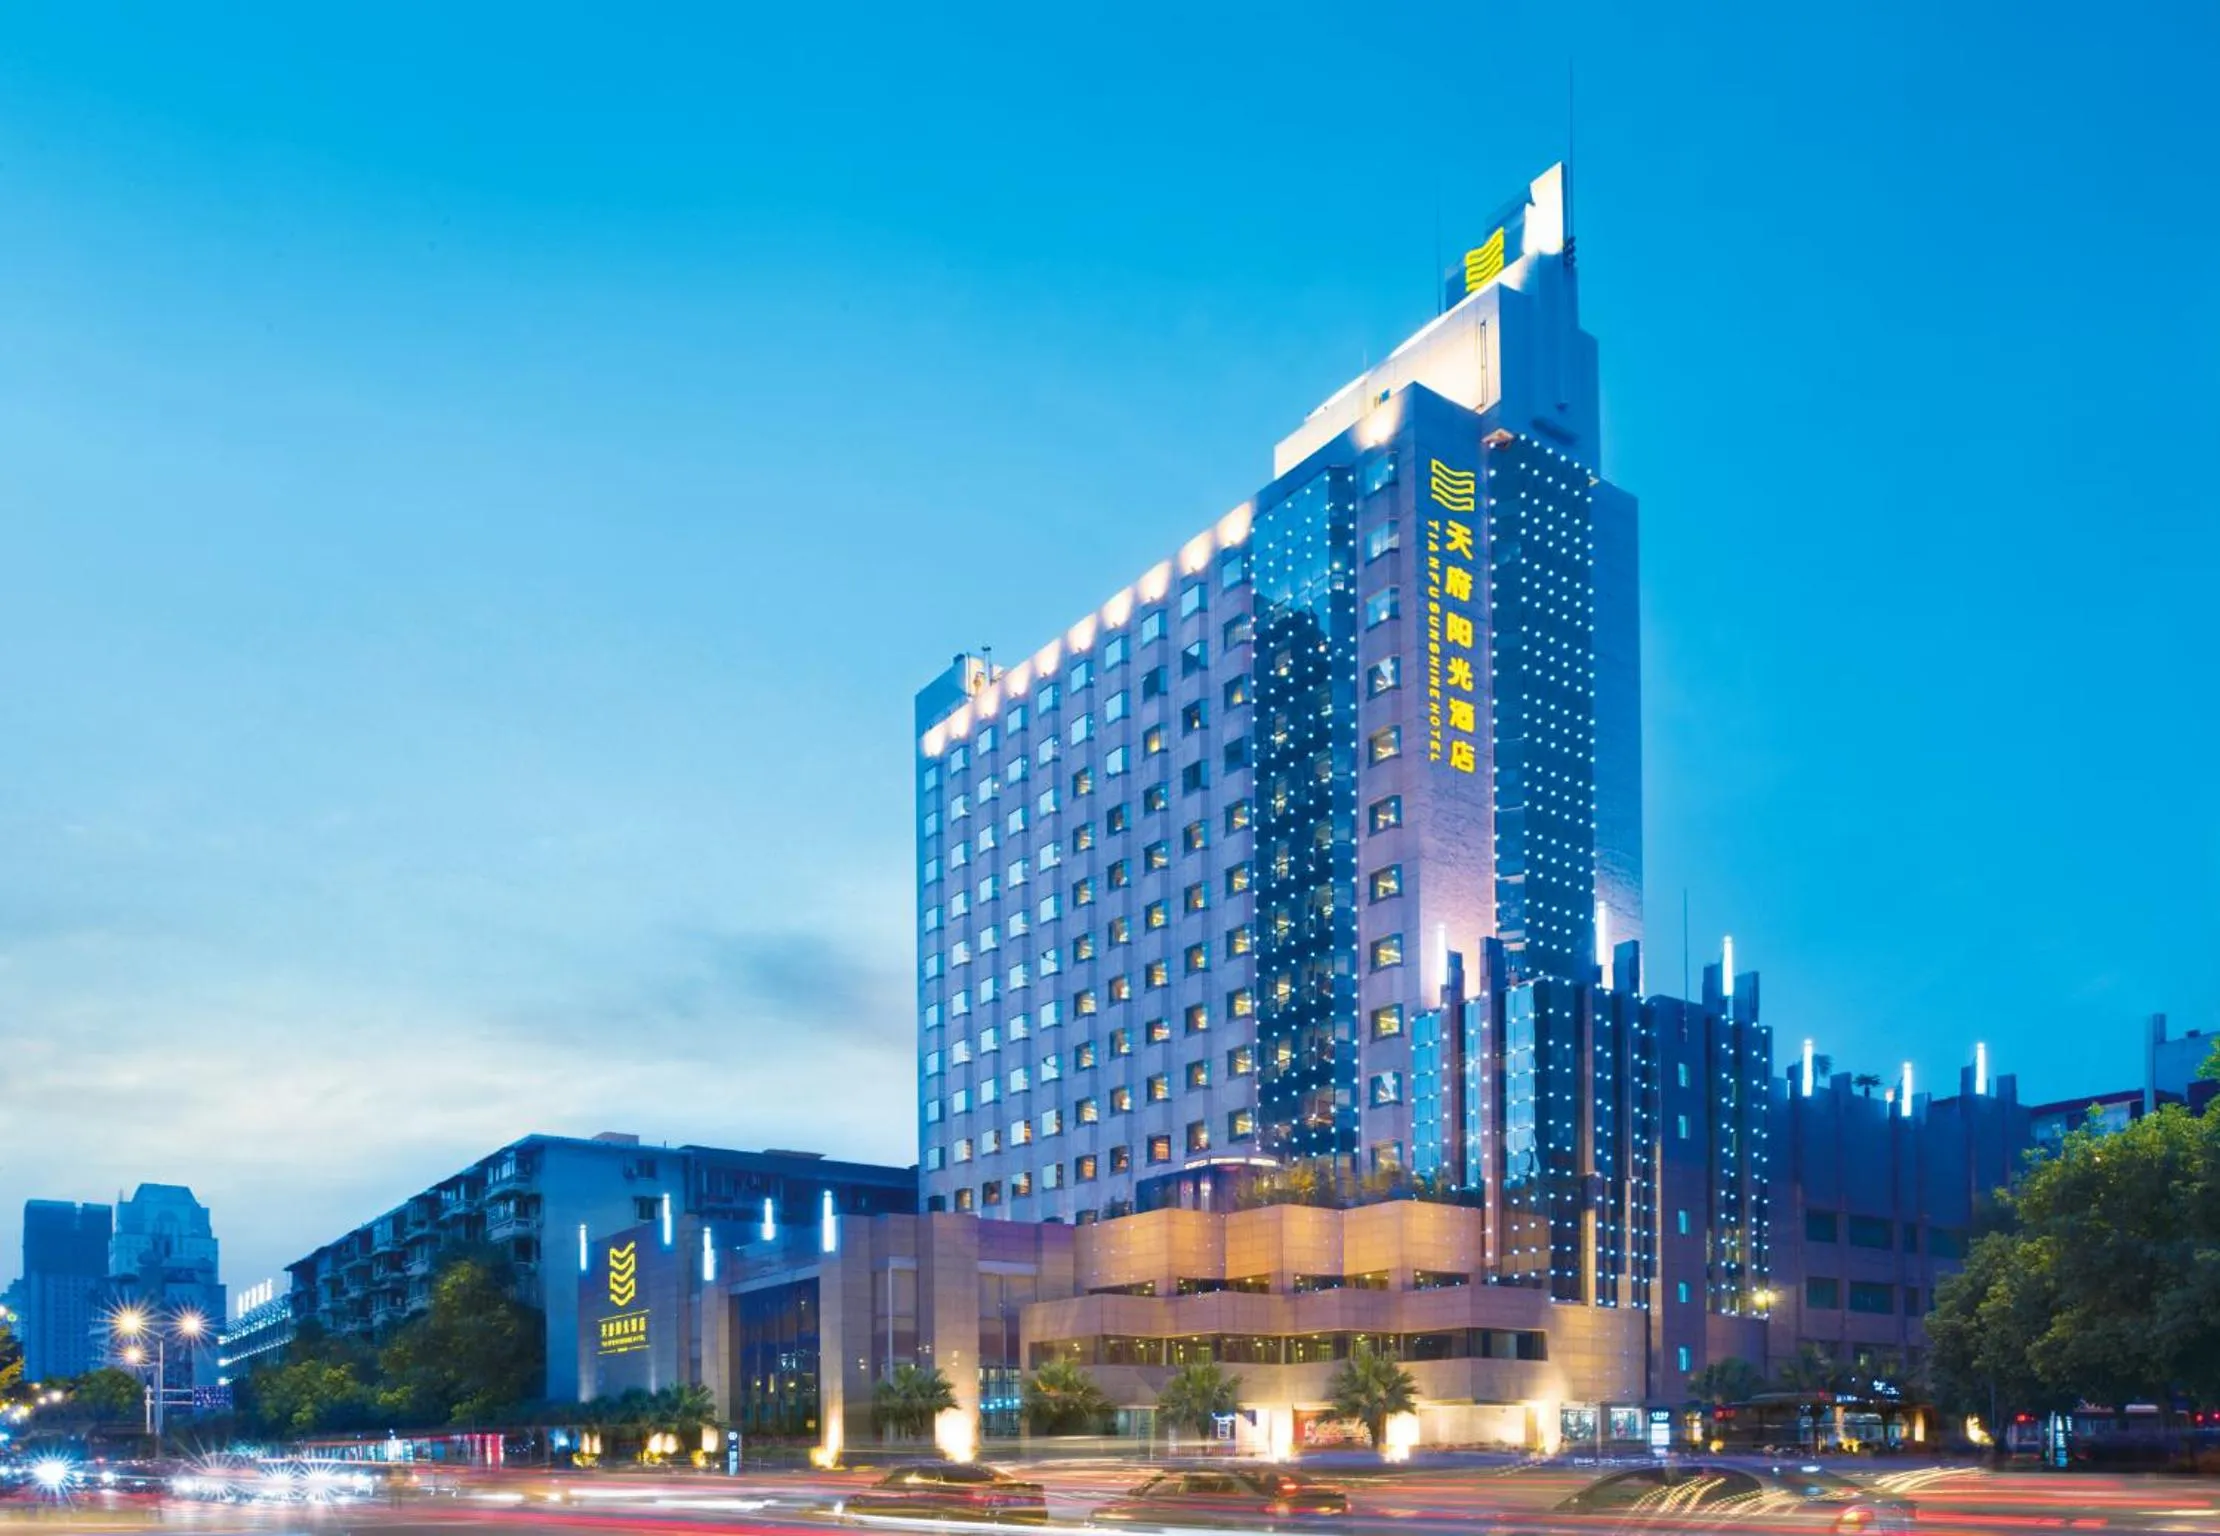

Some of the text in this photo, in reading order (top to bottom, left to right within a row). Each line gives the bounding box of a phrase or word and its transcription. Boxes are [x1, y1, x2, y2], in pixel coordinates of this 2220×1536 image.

[1428, 520, 1441, 761] TIANFU SUNSHINE HOTEL
[1445, 520, 1475, 773] 天府阳光酒店
